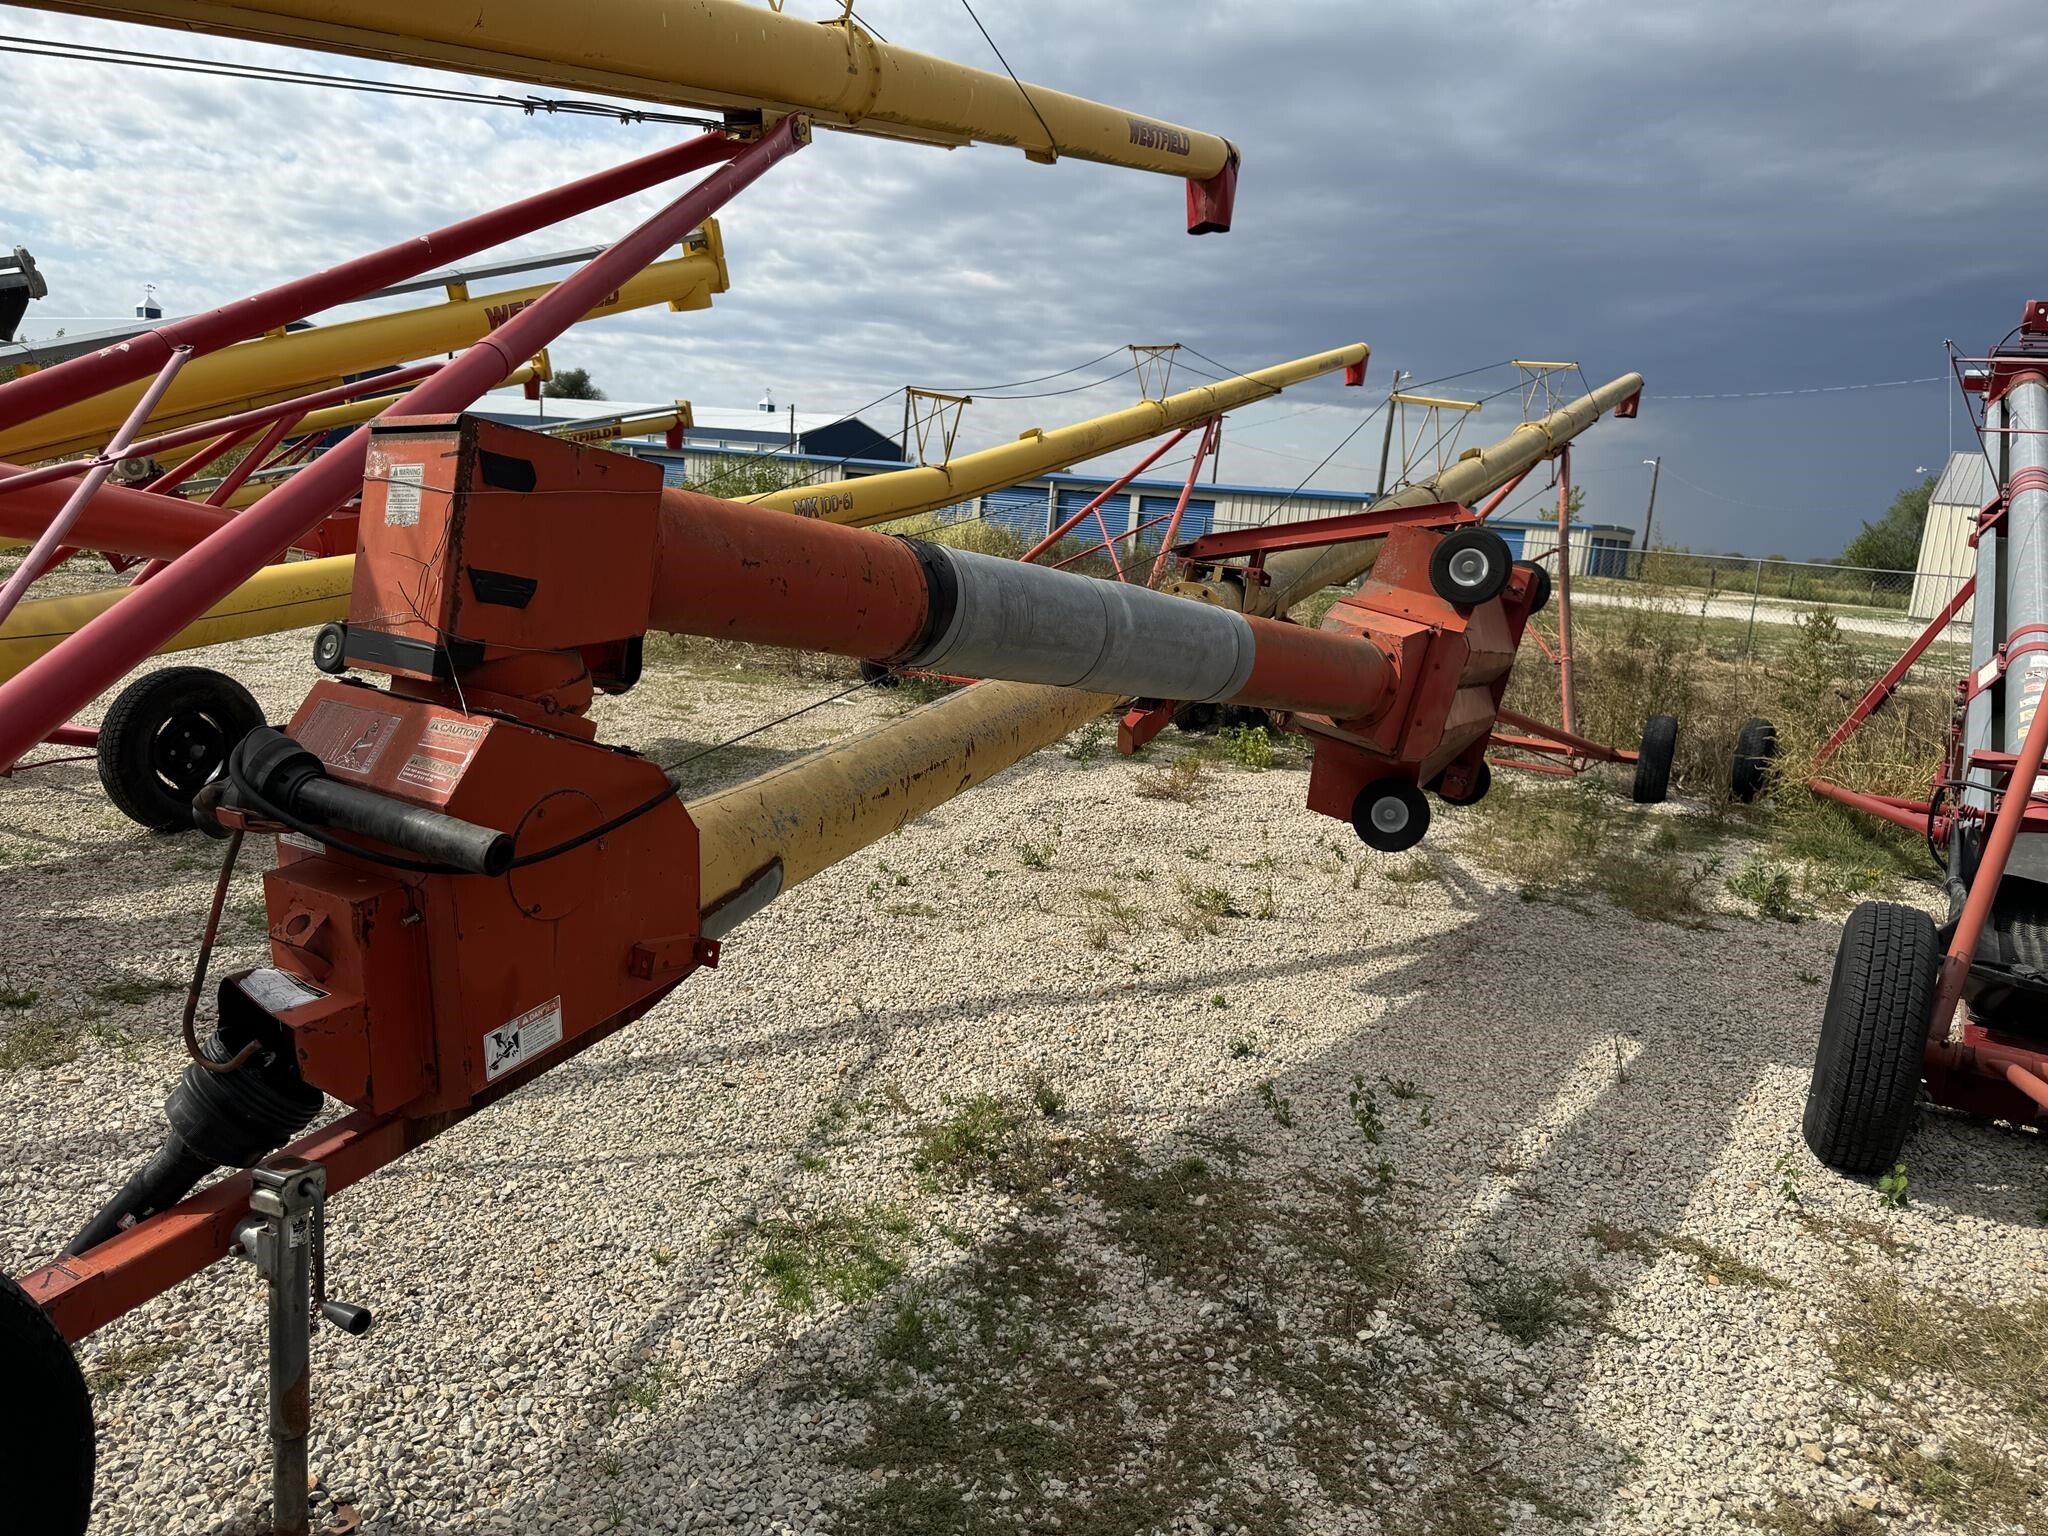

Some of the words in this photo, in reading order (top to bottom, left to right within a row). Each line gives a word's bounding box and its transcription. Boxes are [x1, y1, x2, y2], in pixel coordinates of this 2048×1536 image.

[1127, 119, 1191, 156] WESTFIELD
[570, 427, 612, 443] TFIELD
[398, 468, 421, 476] WARNING
[793, 496, 820, 518] MK
[820, 491, 854, 515] 100-61
[439, 724, 481, 738] CAUTION
